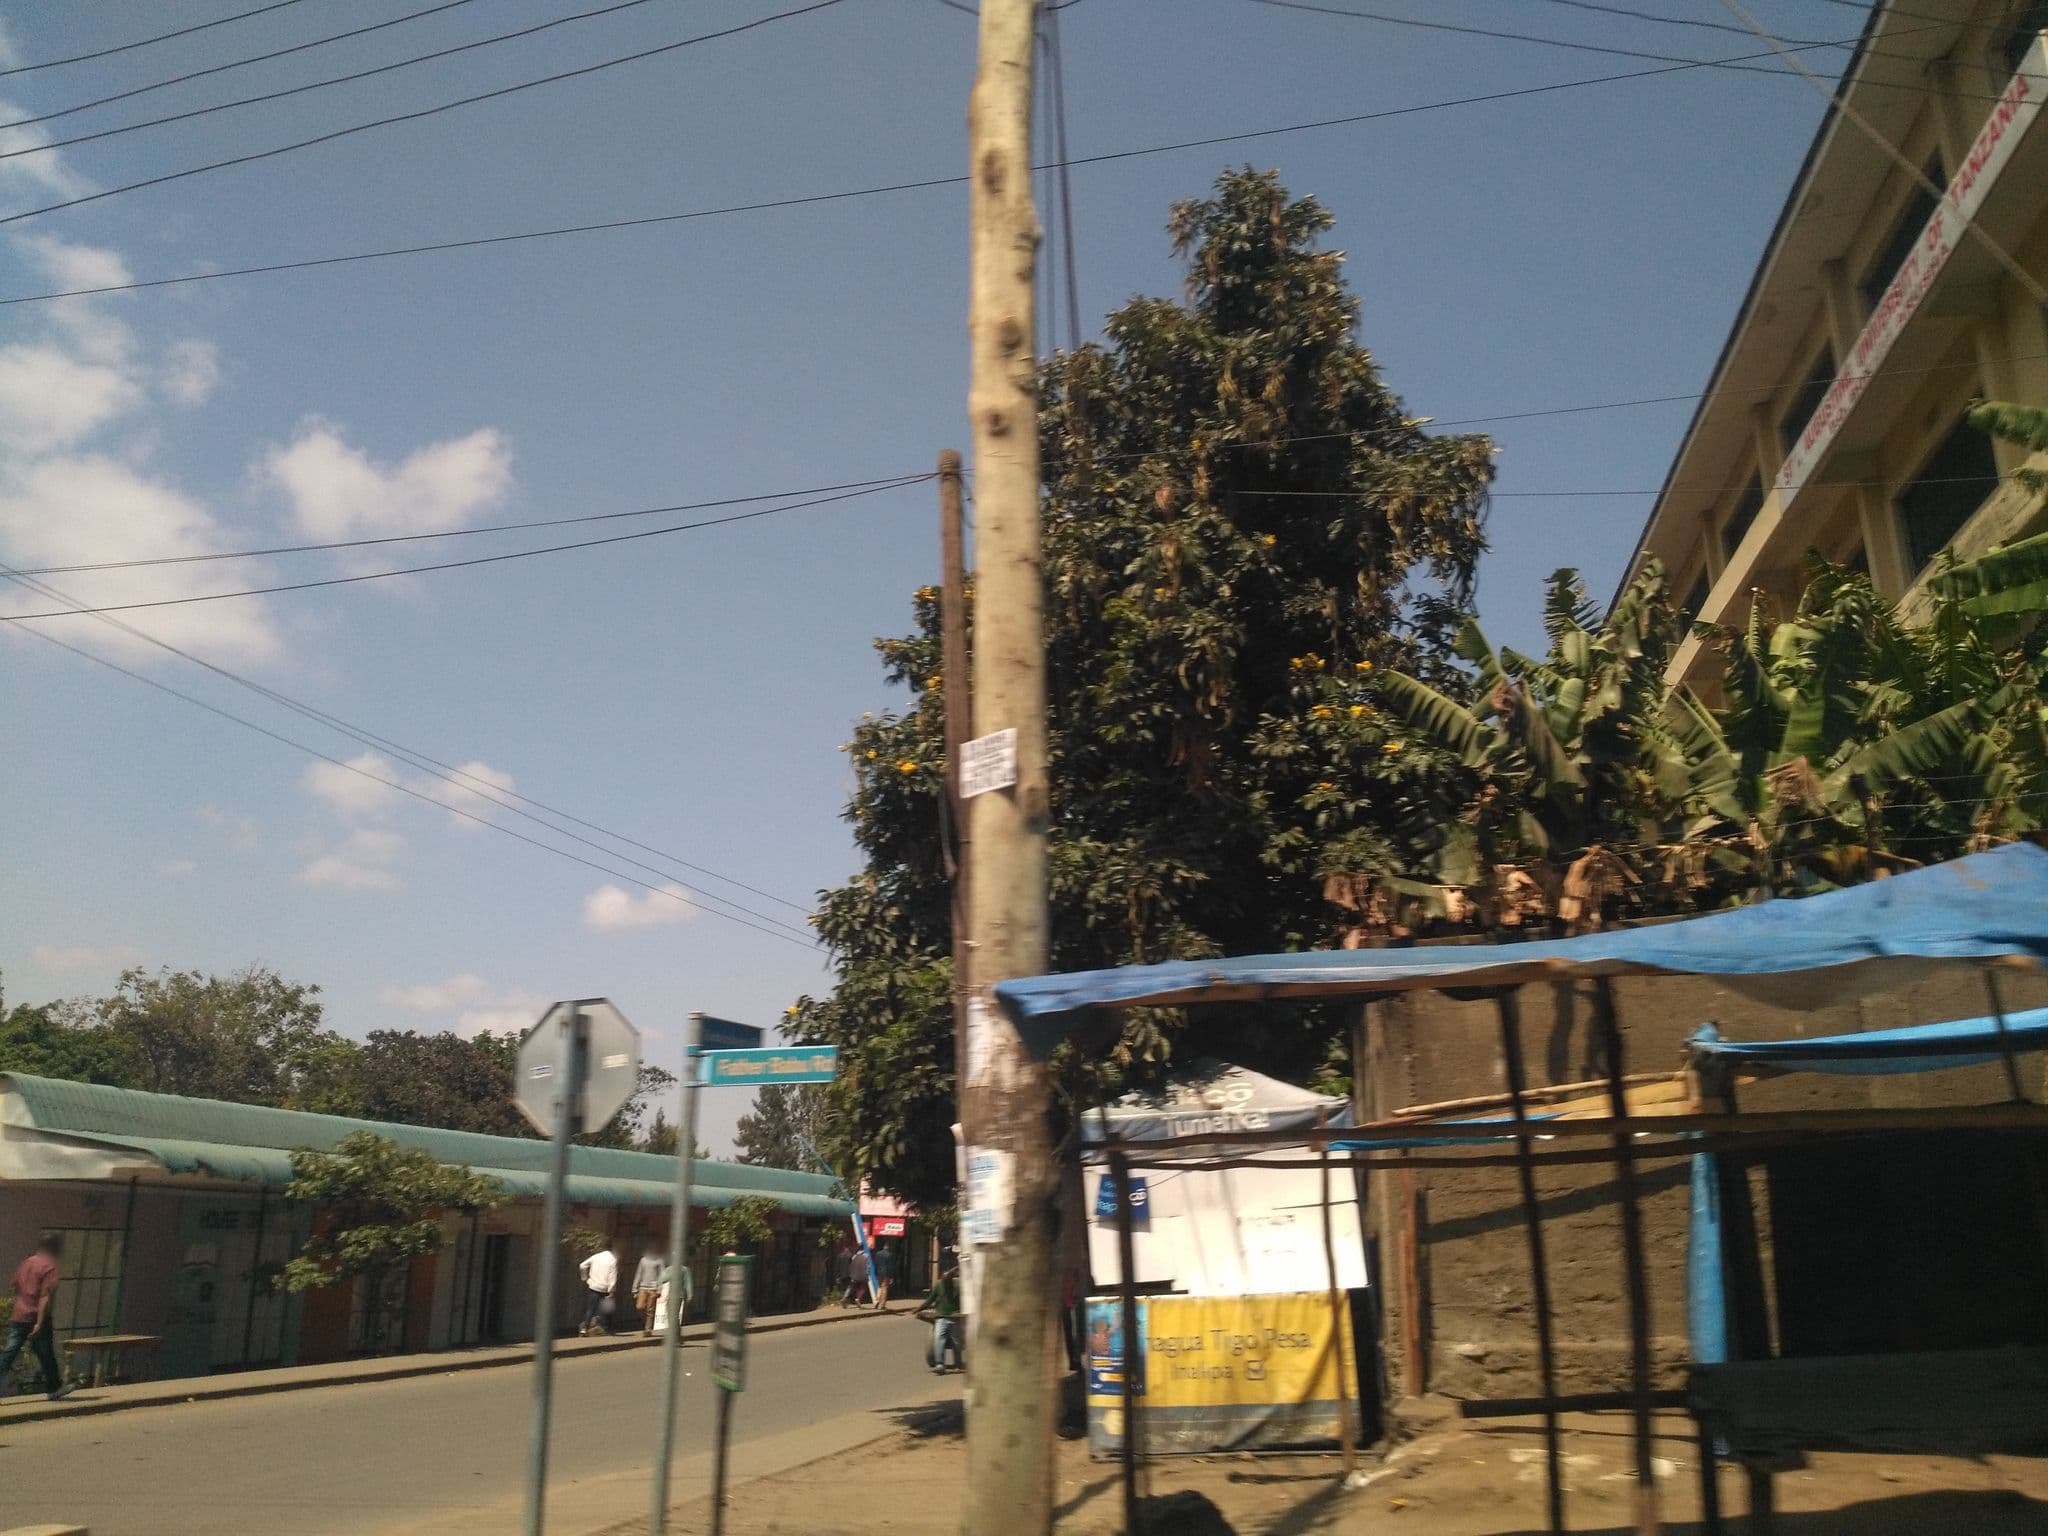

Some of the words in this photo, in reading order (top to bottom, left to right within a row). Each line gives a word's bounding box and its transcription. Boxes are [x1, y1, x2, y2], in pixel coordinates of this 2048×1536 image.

[1926, 210, 1943, 250] OF
[1950, 74, 2029, 208] TANZANIA
[1209, 1329, 1257, 1357] Tigo
[1263, 1327, 1313, 1349] Pesa
